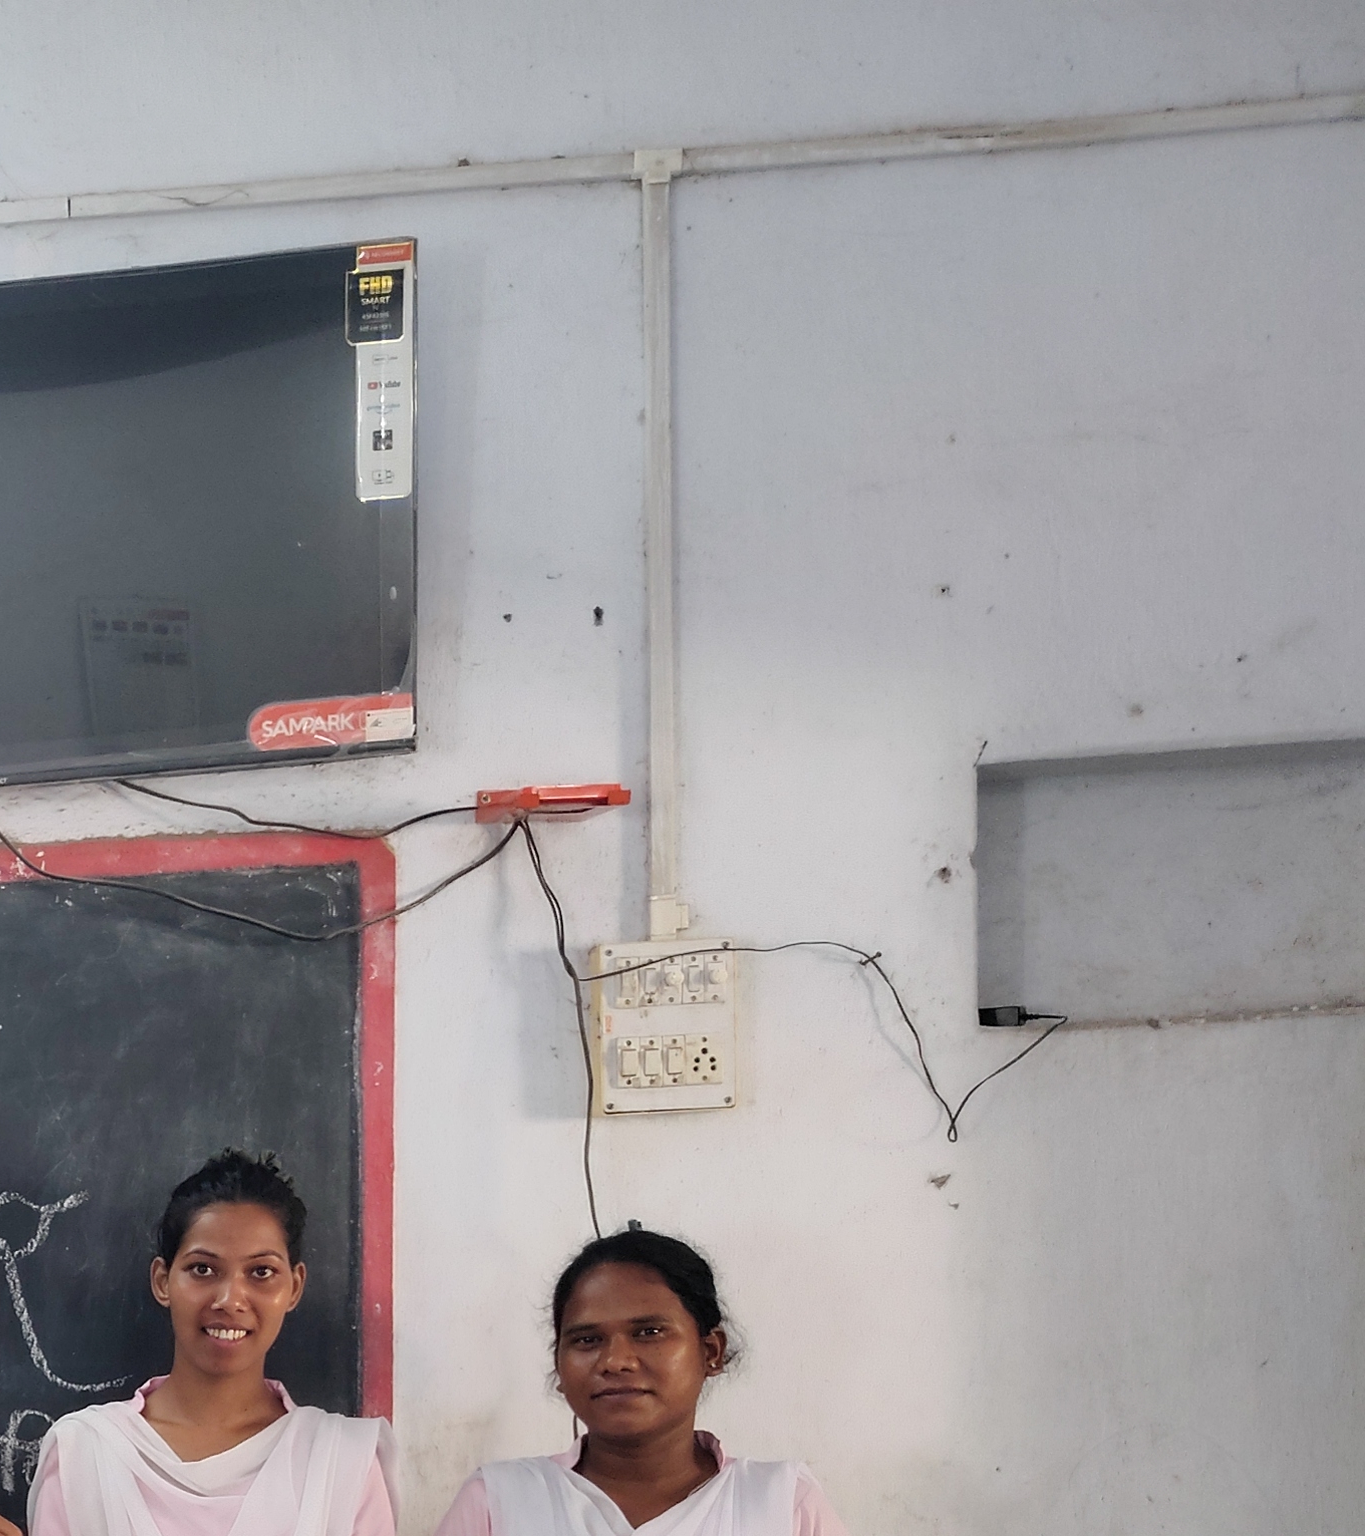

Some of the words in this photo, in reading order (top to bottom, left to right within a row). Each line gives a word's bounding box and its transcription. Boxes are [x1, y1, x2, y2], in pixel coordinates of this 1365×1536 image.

[359, 275, 393, 296] FHD
[361, 295, 391, 306] SMART
[262, 712, 355, 738] SAMPARK
